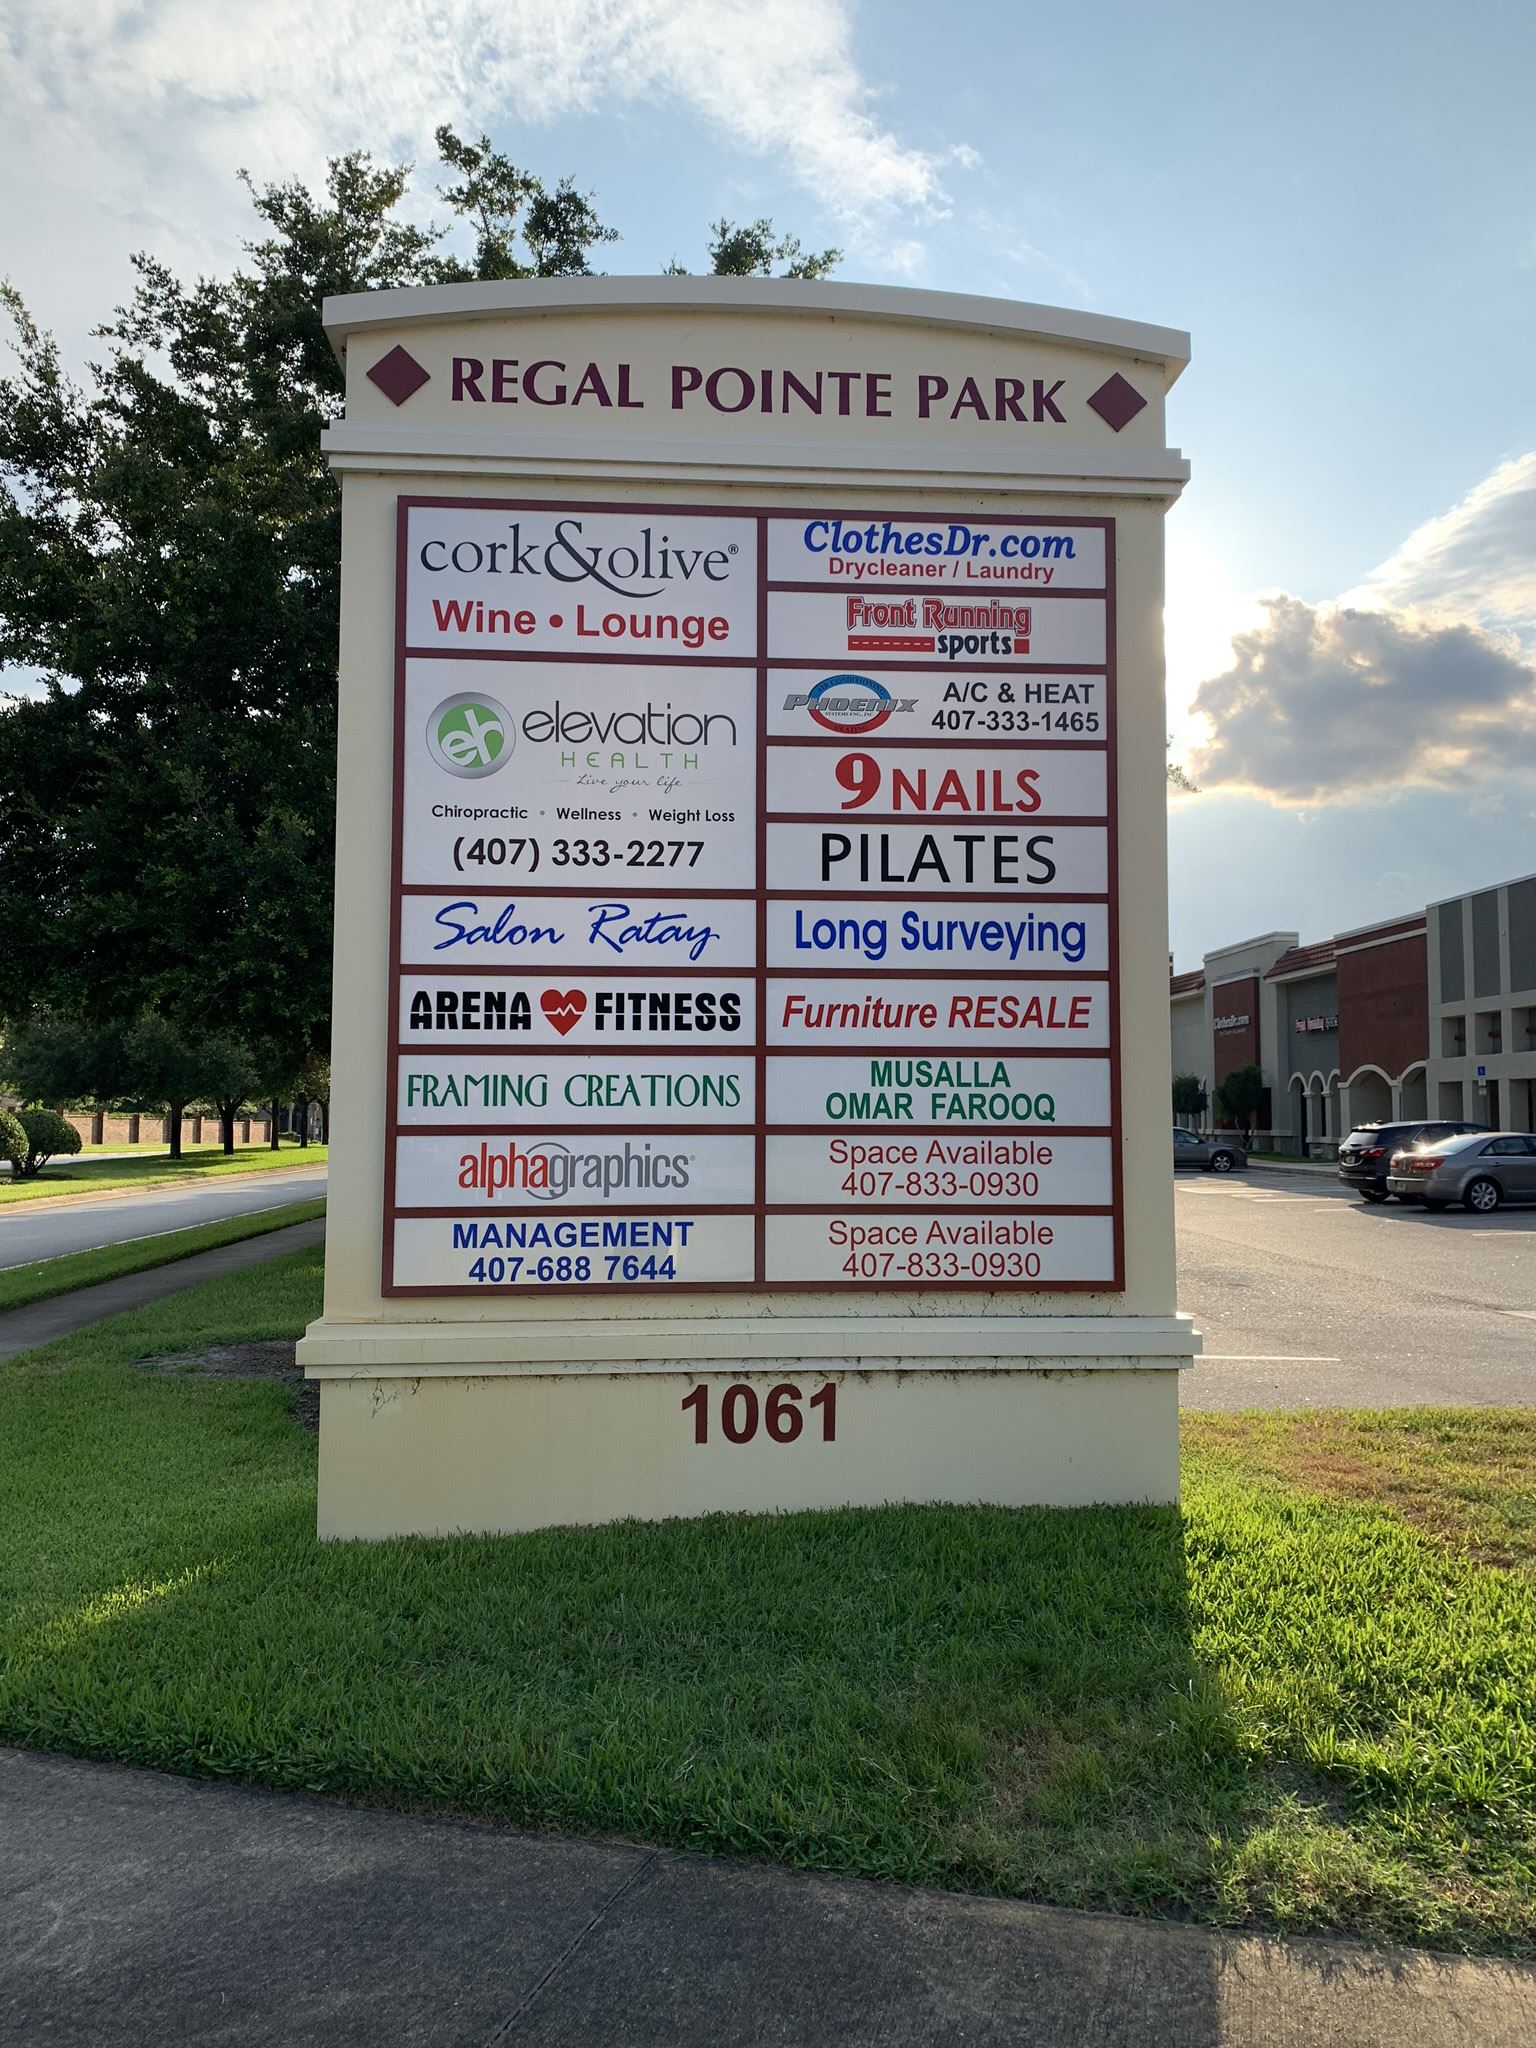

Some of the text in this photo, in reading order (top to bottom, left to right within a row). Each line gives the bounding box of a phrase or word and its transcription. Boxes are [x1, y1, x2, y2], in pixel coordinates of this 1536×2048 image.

[452, 357, 1068, 423] REGAL POINTE PARK
[804, 521, 1076, 559] ClothesDr.com
[829, 557, 947, 579] Drycleaner
[966, 562, 1054, 584] Laundry
[432, 599, 729, 648] Wine Lounge
[847, 596, 1031, 636] Front Running
[938, 631, 1012, 659] sports
[943, 682, 1095, 704] A/C & HEAT
[522, 700, 737, 746] elevation
[931, 710, 1100, 732] 407-333-1465
[560, 751, 699, 770] HEALTH
[656, 775, 682, 794] life
[835, 752, 1042, 812] 9 NAILS
[431, 804, 735, 824] Chiropractic Wellness Weight Loss
[453, 836, 705, 872] (407) 333-2277
[821, 832, 1057, 884] PILATES
[433, 901, 720, 961] Salon Ratay
[795, 910, 1086, 962] Long Surveying
[409, 991, 742, 1032] ARENA FITNESS
[782, 995, 1093, 1029] Furniture RESALE
[870, 1060, 1011, 1088] MUSALLA
[407, 1074, 742, 1107] FRAMING CREATIONS
[825, 1092, 1056, 1123] OMAR FAROOQ
[829, 1139, 1053, 1169] Space Available
[841, 1171, 1039, 1197] 407-833-0930
[453, 1221, 694, 1249] MANAGEMENT
[828, 1220, 1054, 1251] Space Available
[468, 1254, 676, 1282] 407-688 7644
[842, 1252, 1041, 1278] 407-833-0930
[681, 1383, 836, 1444] 1061
